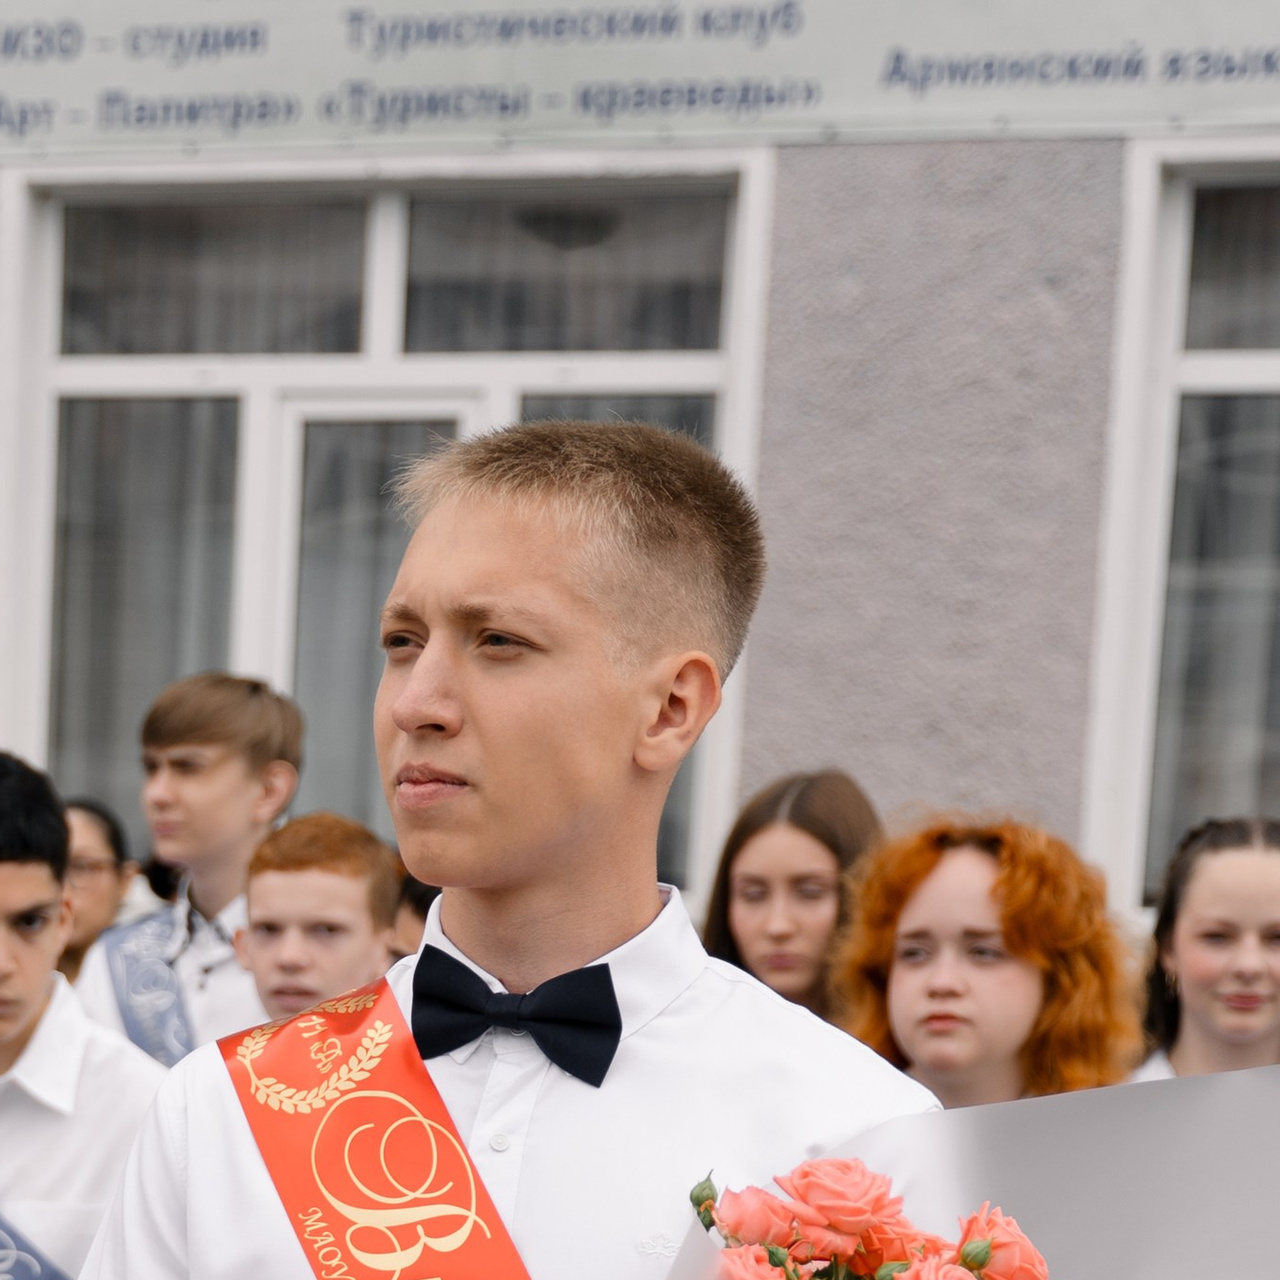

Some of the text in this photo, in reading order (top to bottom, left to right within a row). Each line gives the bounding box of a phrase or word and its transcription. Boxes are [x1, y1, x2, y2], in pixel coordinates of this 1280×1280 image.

[125, 24, 267, 69] студия
[344, 3, 804, 58] Туристический клуб
[881, 42, 1146, 98] Армянский
[317, 80, 529, 129] «Туристы
[576, 78, 822, 121] краеведы»
